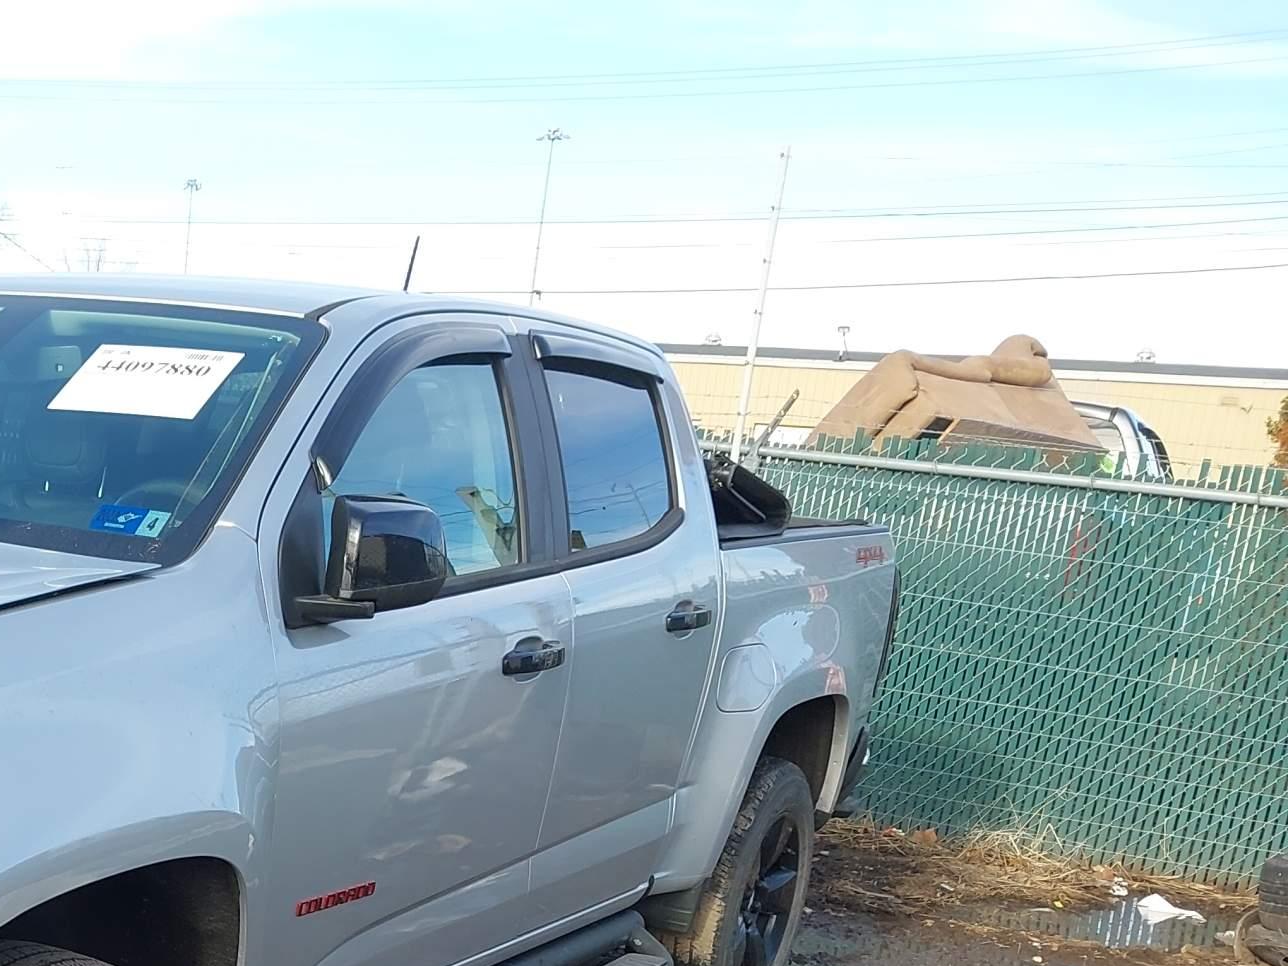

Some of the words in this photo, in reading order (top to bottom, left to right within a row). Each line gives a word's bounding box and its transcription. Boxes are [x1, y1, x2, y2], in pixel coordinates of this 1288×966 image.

[96, 358, 212, 377] 44097880
[146, 517, 159, 531] 4
[296, 880, 377, 917] COLORADO
